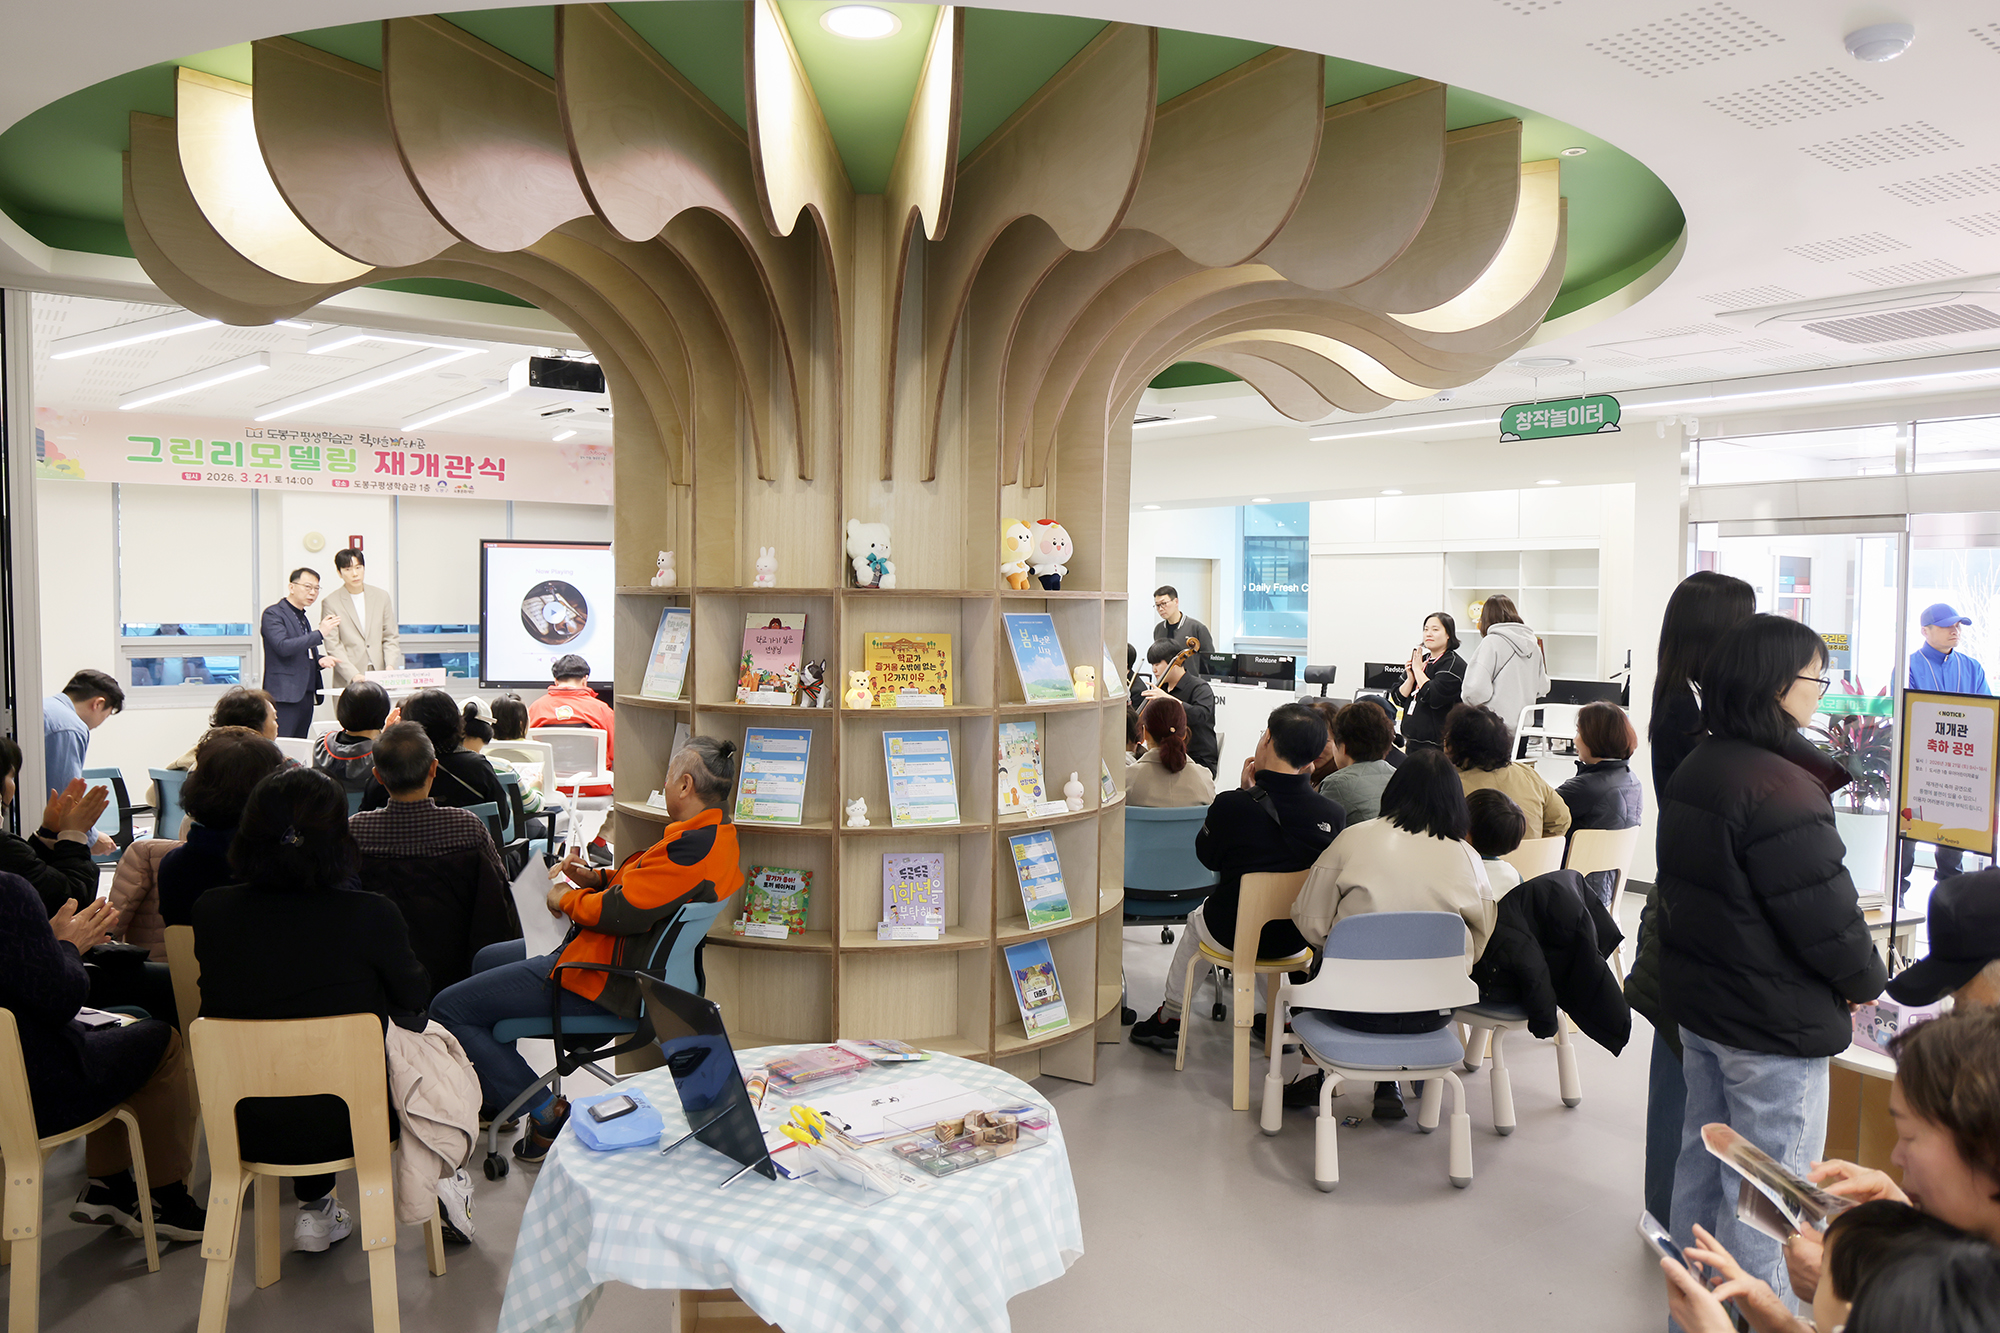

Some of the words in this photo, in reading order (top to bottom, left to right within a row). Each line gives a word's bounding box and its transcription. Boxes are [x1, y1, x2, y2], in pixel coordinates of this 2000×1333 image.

[1516, 403, 1603, 431] 창작놀이터
[127, 436, 357, 472] 그린리모델링
[374, 451, 505, 481] 재개관식
[206, 472, 236, 481] 2026.
[240, 472, 252, 483] 3.
[254, 473, 271, 484] 21.
[285, 476, 314, 485] 14:00
[354, 480, 417, 491] 도봉구평생학습관
[419, 483, 431, 492] 1층
[1248, 582, 1271, 594] Daily
[1273, 583, 1299, 593] Fresh
[782, 635, 794, 645] 싫은
[765, 646, 782, 655] 선생님
[897, 653, 921, 663] 학교가
[1255, 656, 1277, 664] Redstone
[875, 662, 898, 671] 즐거울
[900, 663, 921, 671] 수밖에
[922, 662, 936, 671] 없는
[1384, 665, 1405, 673] Redsto
[883, 673, 908, 682] 12가지
[910, 672, 925, 682] 이유
[1935, 722, 1968, 738] 재개관
[1927, 739, 1949, 753] 축하
[1952, 742, 1974, 757] 공연
[899, 865, 928, 880] 두근두근
[889, 878, 943, 905] 1학년을
[900, 905, 932, 921] 부탁해
